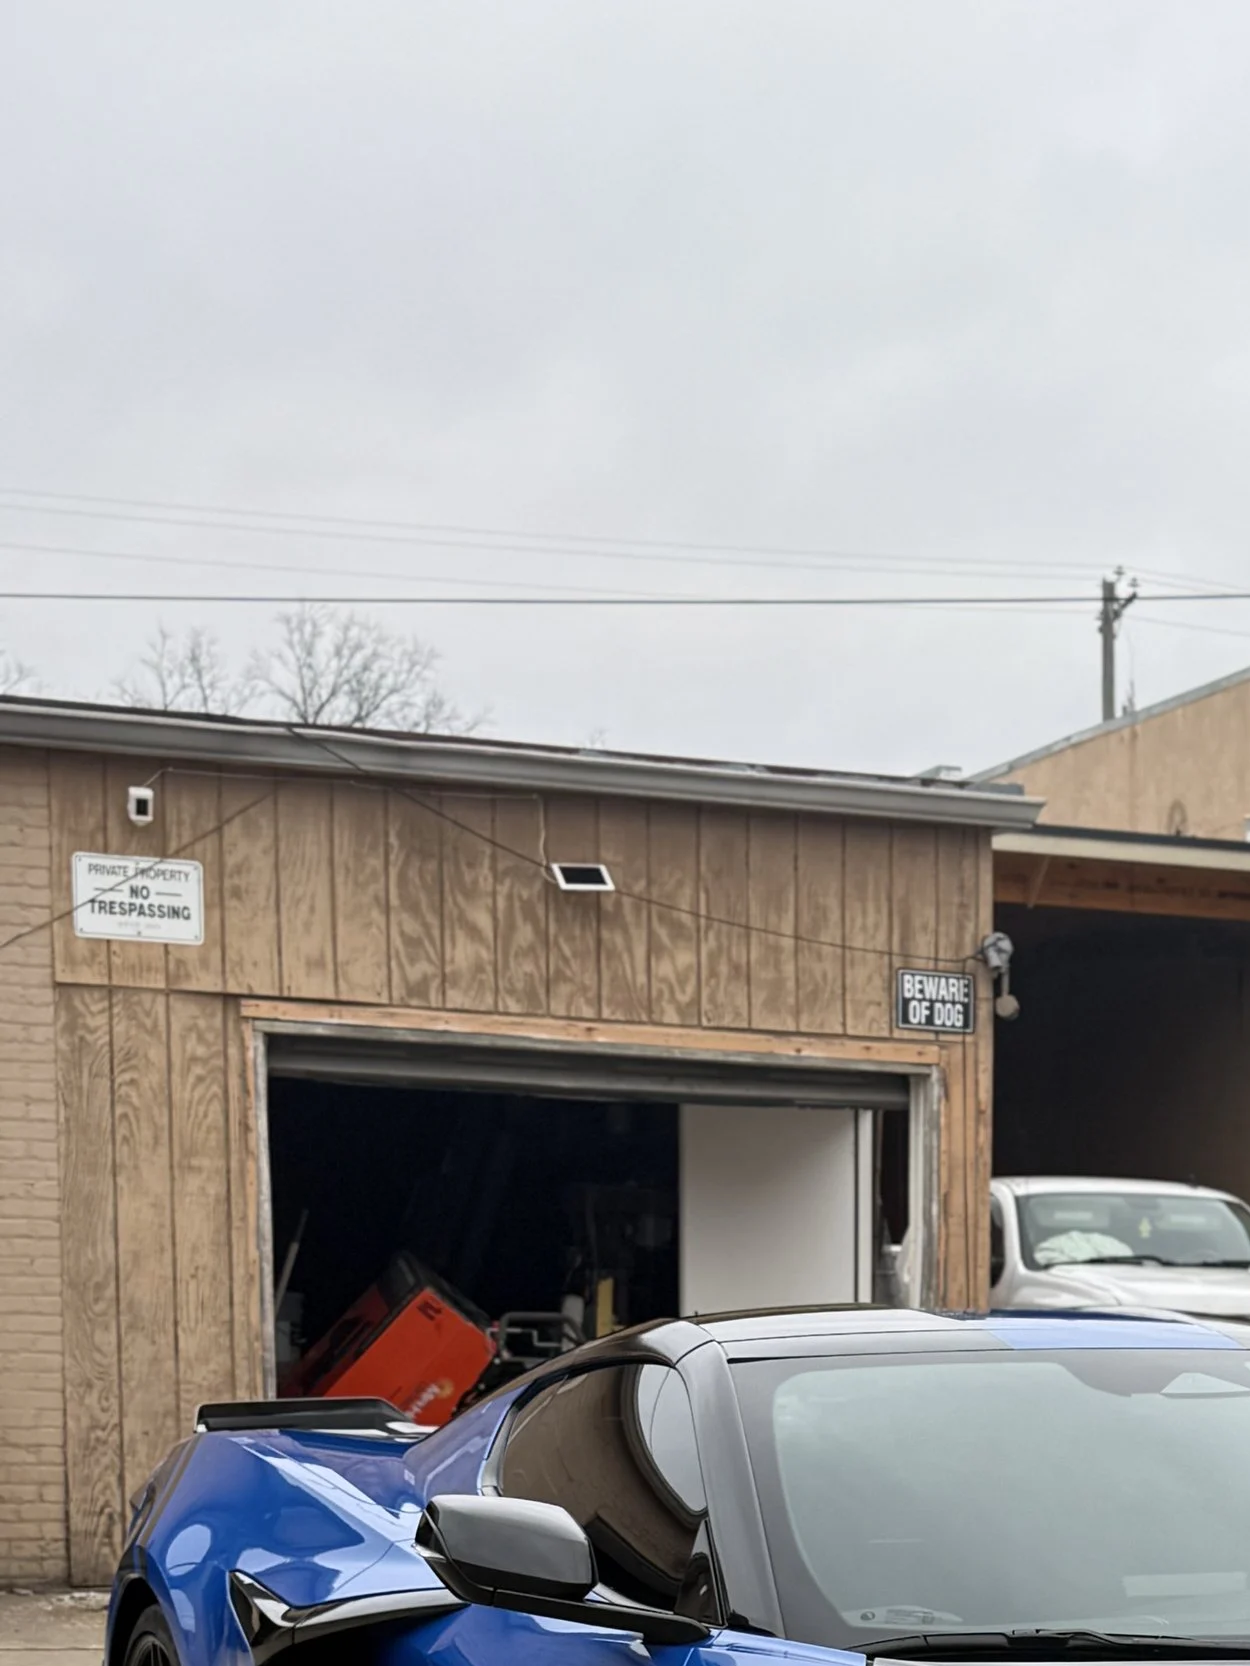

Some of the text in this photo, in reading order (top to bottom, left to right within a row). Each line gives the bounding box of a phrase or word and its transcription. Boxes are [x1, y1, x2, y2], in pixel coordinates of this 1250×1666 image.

[88, 863, 190, 882] PRIVATE PROPERTY
[129, 884, 150, 900] NO
[89, 899, 191, 920] TRESPASSING
[903, 974, 969, 1003] BEWARE
[908, 1000, 964, 1027] OF DOG
